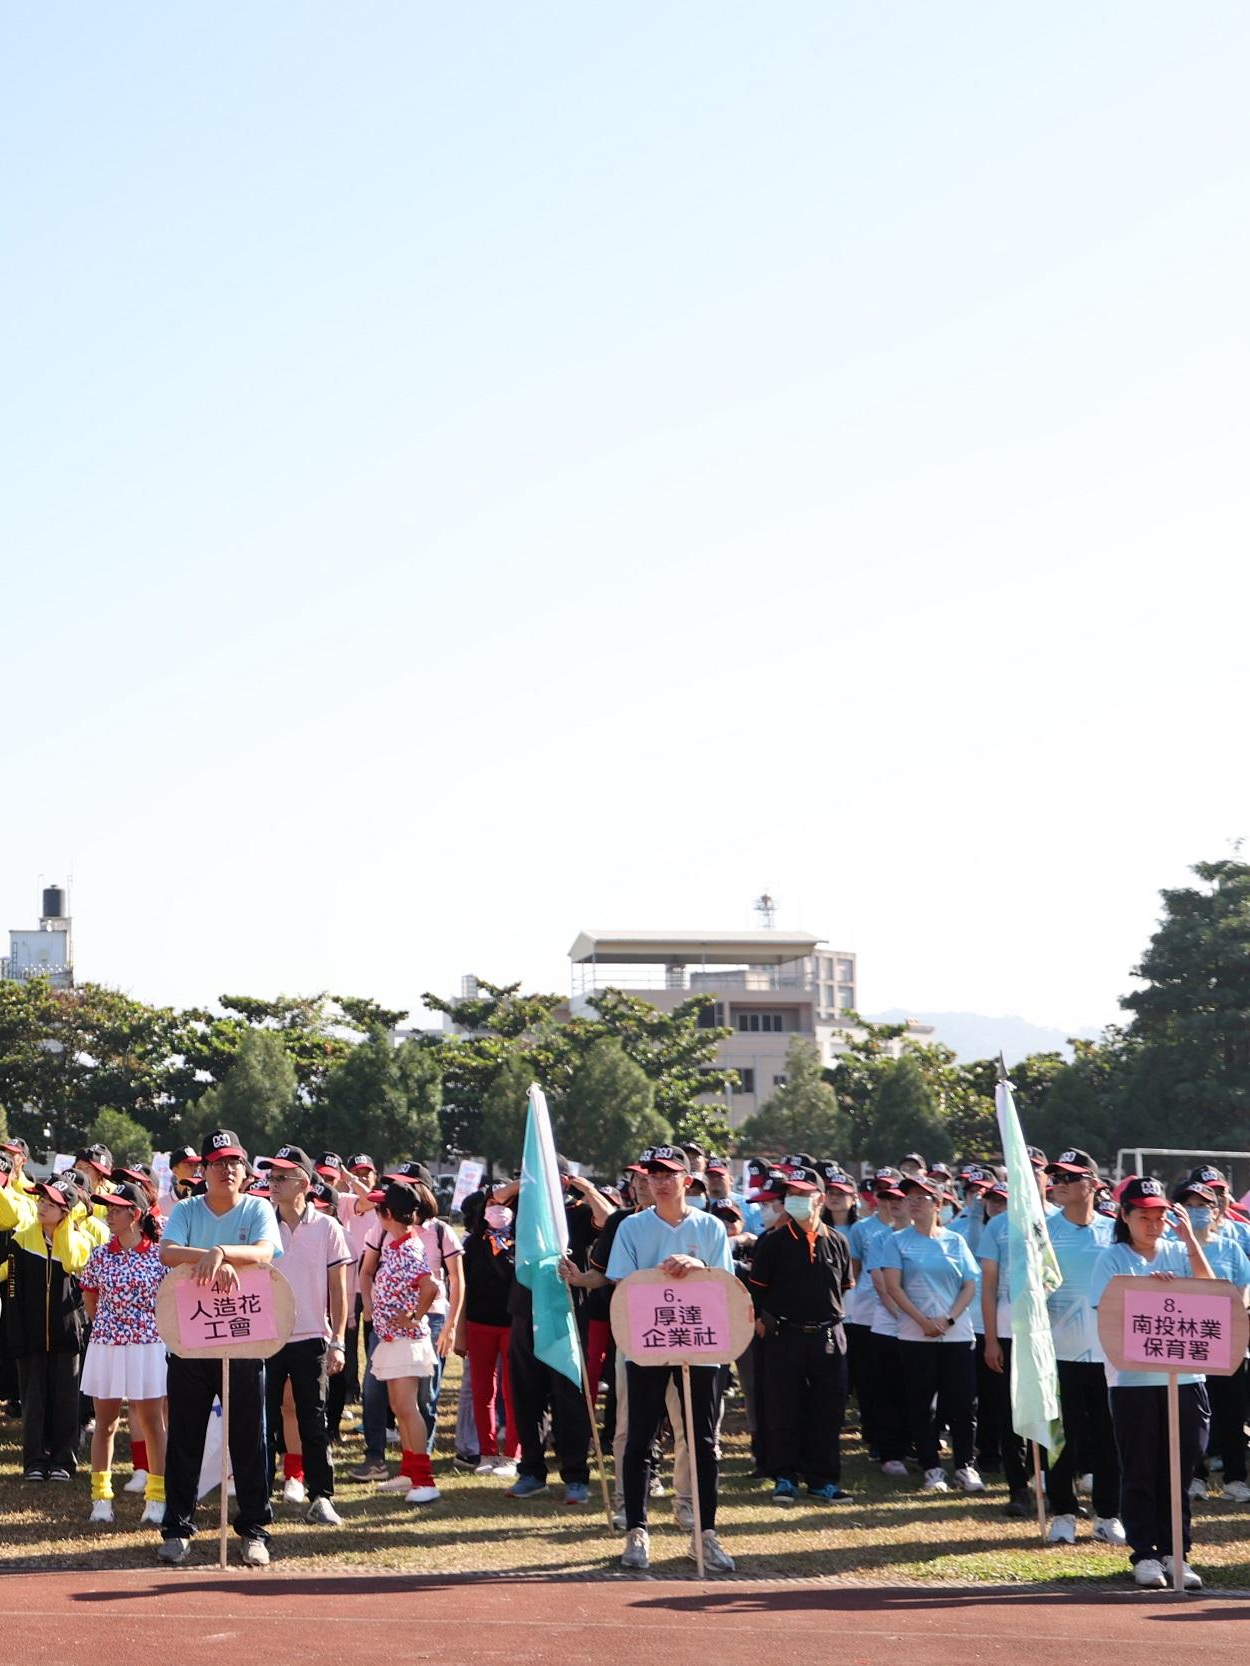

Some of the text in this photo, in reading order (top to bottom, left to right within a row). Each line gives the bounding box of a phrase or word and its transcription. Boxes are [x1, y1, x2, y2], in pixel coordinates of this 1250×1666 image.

[663, 1288, 682, 1303] 6.
[1164, 1298, 1183, 1313] 8.
[190, 1294, 262, 1321] 人造花
[654, 1305, 703, 1326] 厚達
[204, 1316, 251, 1340] 工會
[642, 1327, 718, 1348] 企業社
[1132, 1314, 1222, 1340] 南投林業
[1143, 1337, 1210, 1361] 保育署
